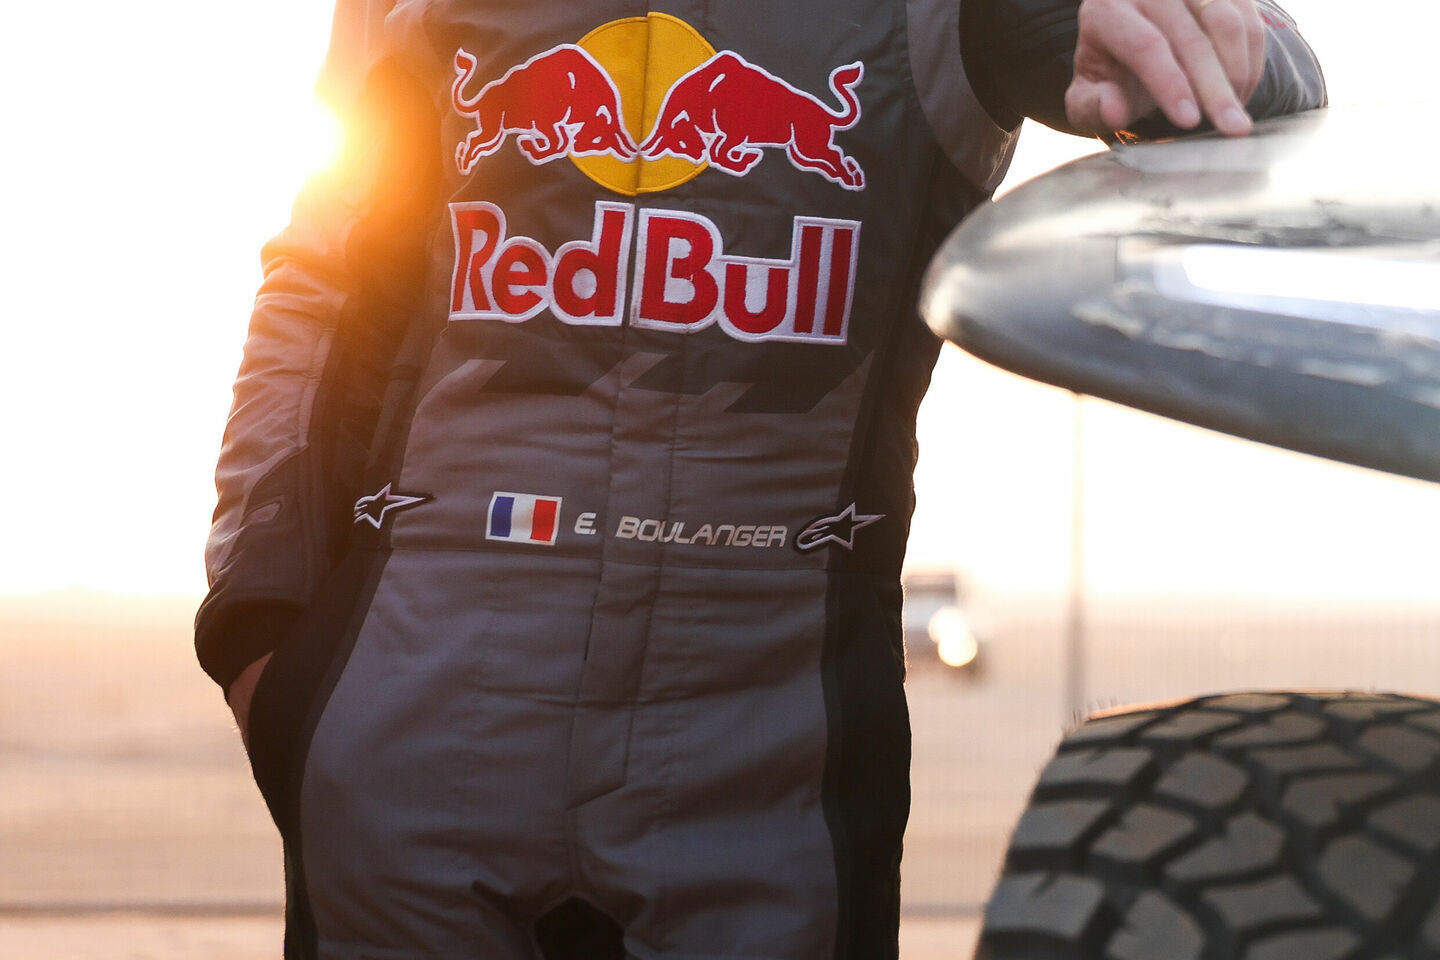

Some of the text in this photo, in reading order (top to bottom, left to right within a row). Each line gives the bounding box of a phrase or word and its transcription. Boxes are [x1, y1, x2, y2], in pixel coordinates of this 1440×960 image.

[449, 200, 862, 345] Red Bull
[574, 512, 787, 548] E. BOULANGER
